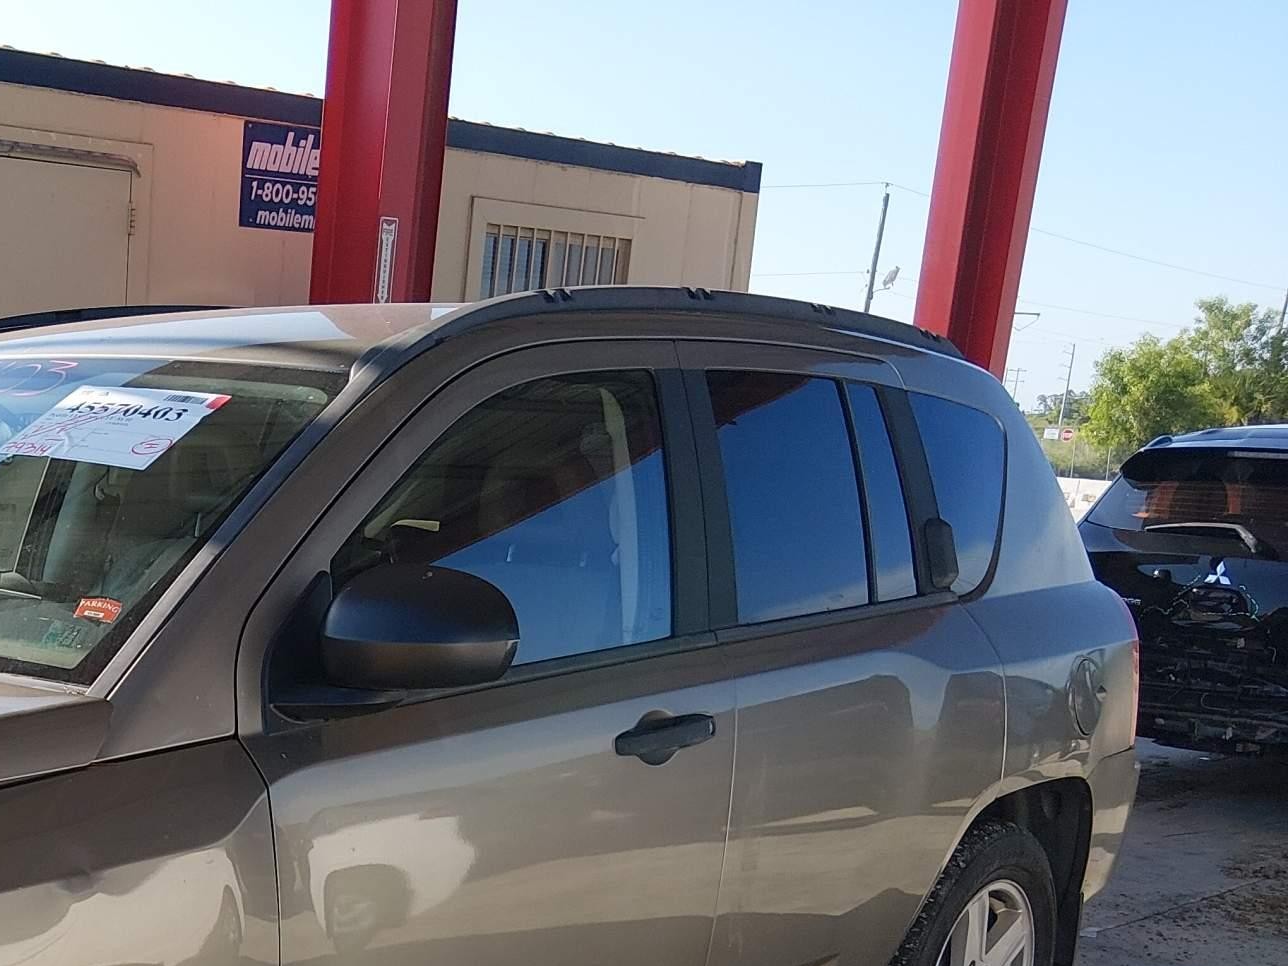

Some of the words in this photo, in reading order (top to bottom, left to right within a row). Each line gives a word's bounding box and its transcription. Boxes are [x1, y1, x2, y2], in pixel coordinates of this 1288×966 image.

[246, 131, 320, 176] mobile
[250, 180, 318, 206] 1-800-95
[256, 207, 315, 229] mobilem
[66, 400, 188, 422] 45570403
